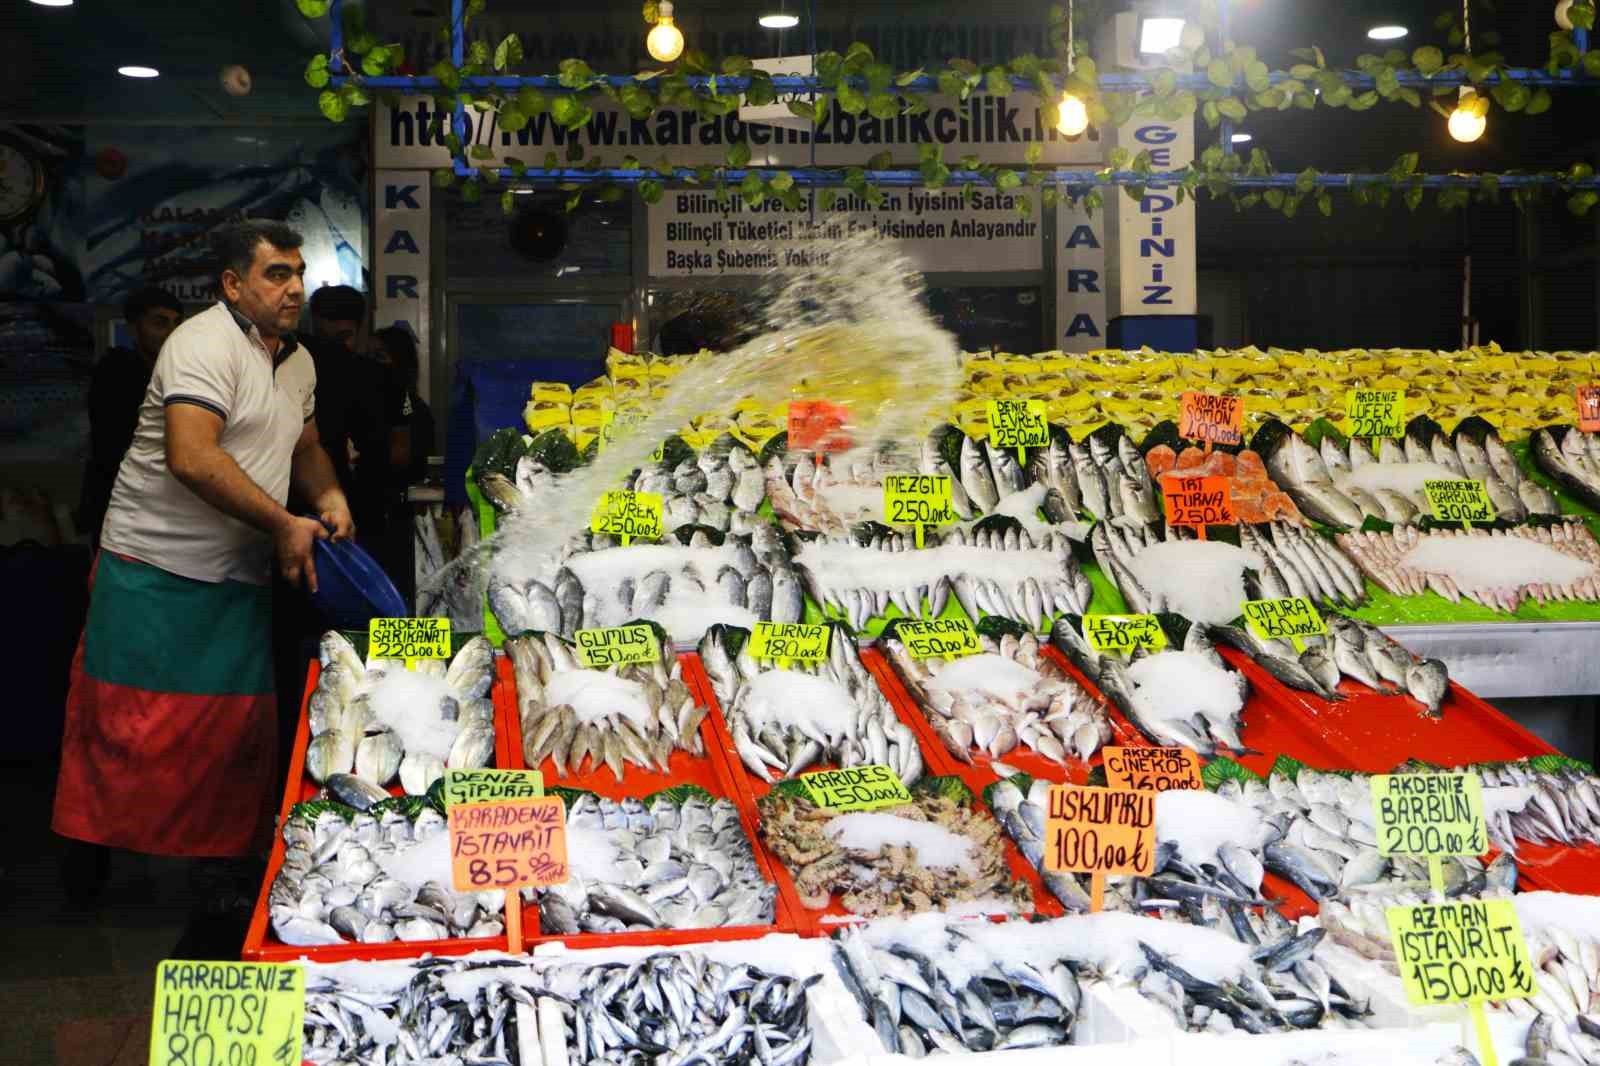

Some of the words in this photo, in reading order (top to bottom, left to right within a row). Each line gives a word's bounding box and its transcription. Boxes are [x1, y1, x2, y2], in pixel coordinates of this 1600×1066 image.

[676, 195, 742, 218] Bilinçli
[878, 192, 901, 211] En
[971, 191, 1021, 210] Sata
[666, 222, 722, 246] Bilinçli
[727, 221, 792, 241] Tüketici
[951, 219, 1037, 241] Anlayandır
[666, 250, 712, 273] Başka
[1166, 491, 1224, 509] TURNA
[372, 629, 448, 644] SARIKANAT
[760, 622, 823, 639] TURNA
[900, 619, 969, 635] MERCAN
[805, 766, 890, 789] KARIDES
[1389, 775, 1465, 795] AKDENIZ
[1381, 792, 1472, 825] BARBUN
[1411, 903, 1490, 929] AZMAN
[163, 964, 296, 992] KARADENIZ
